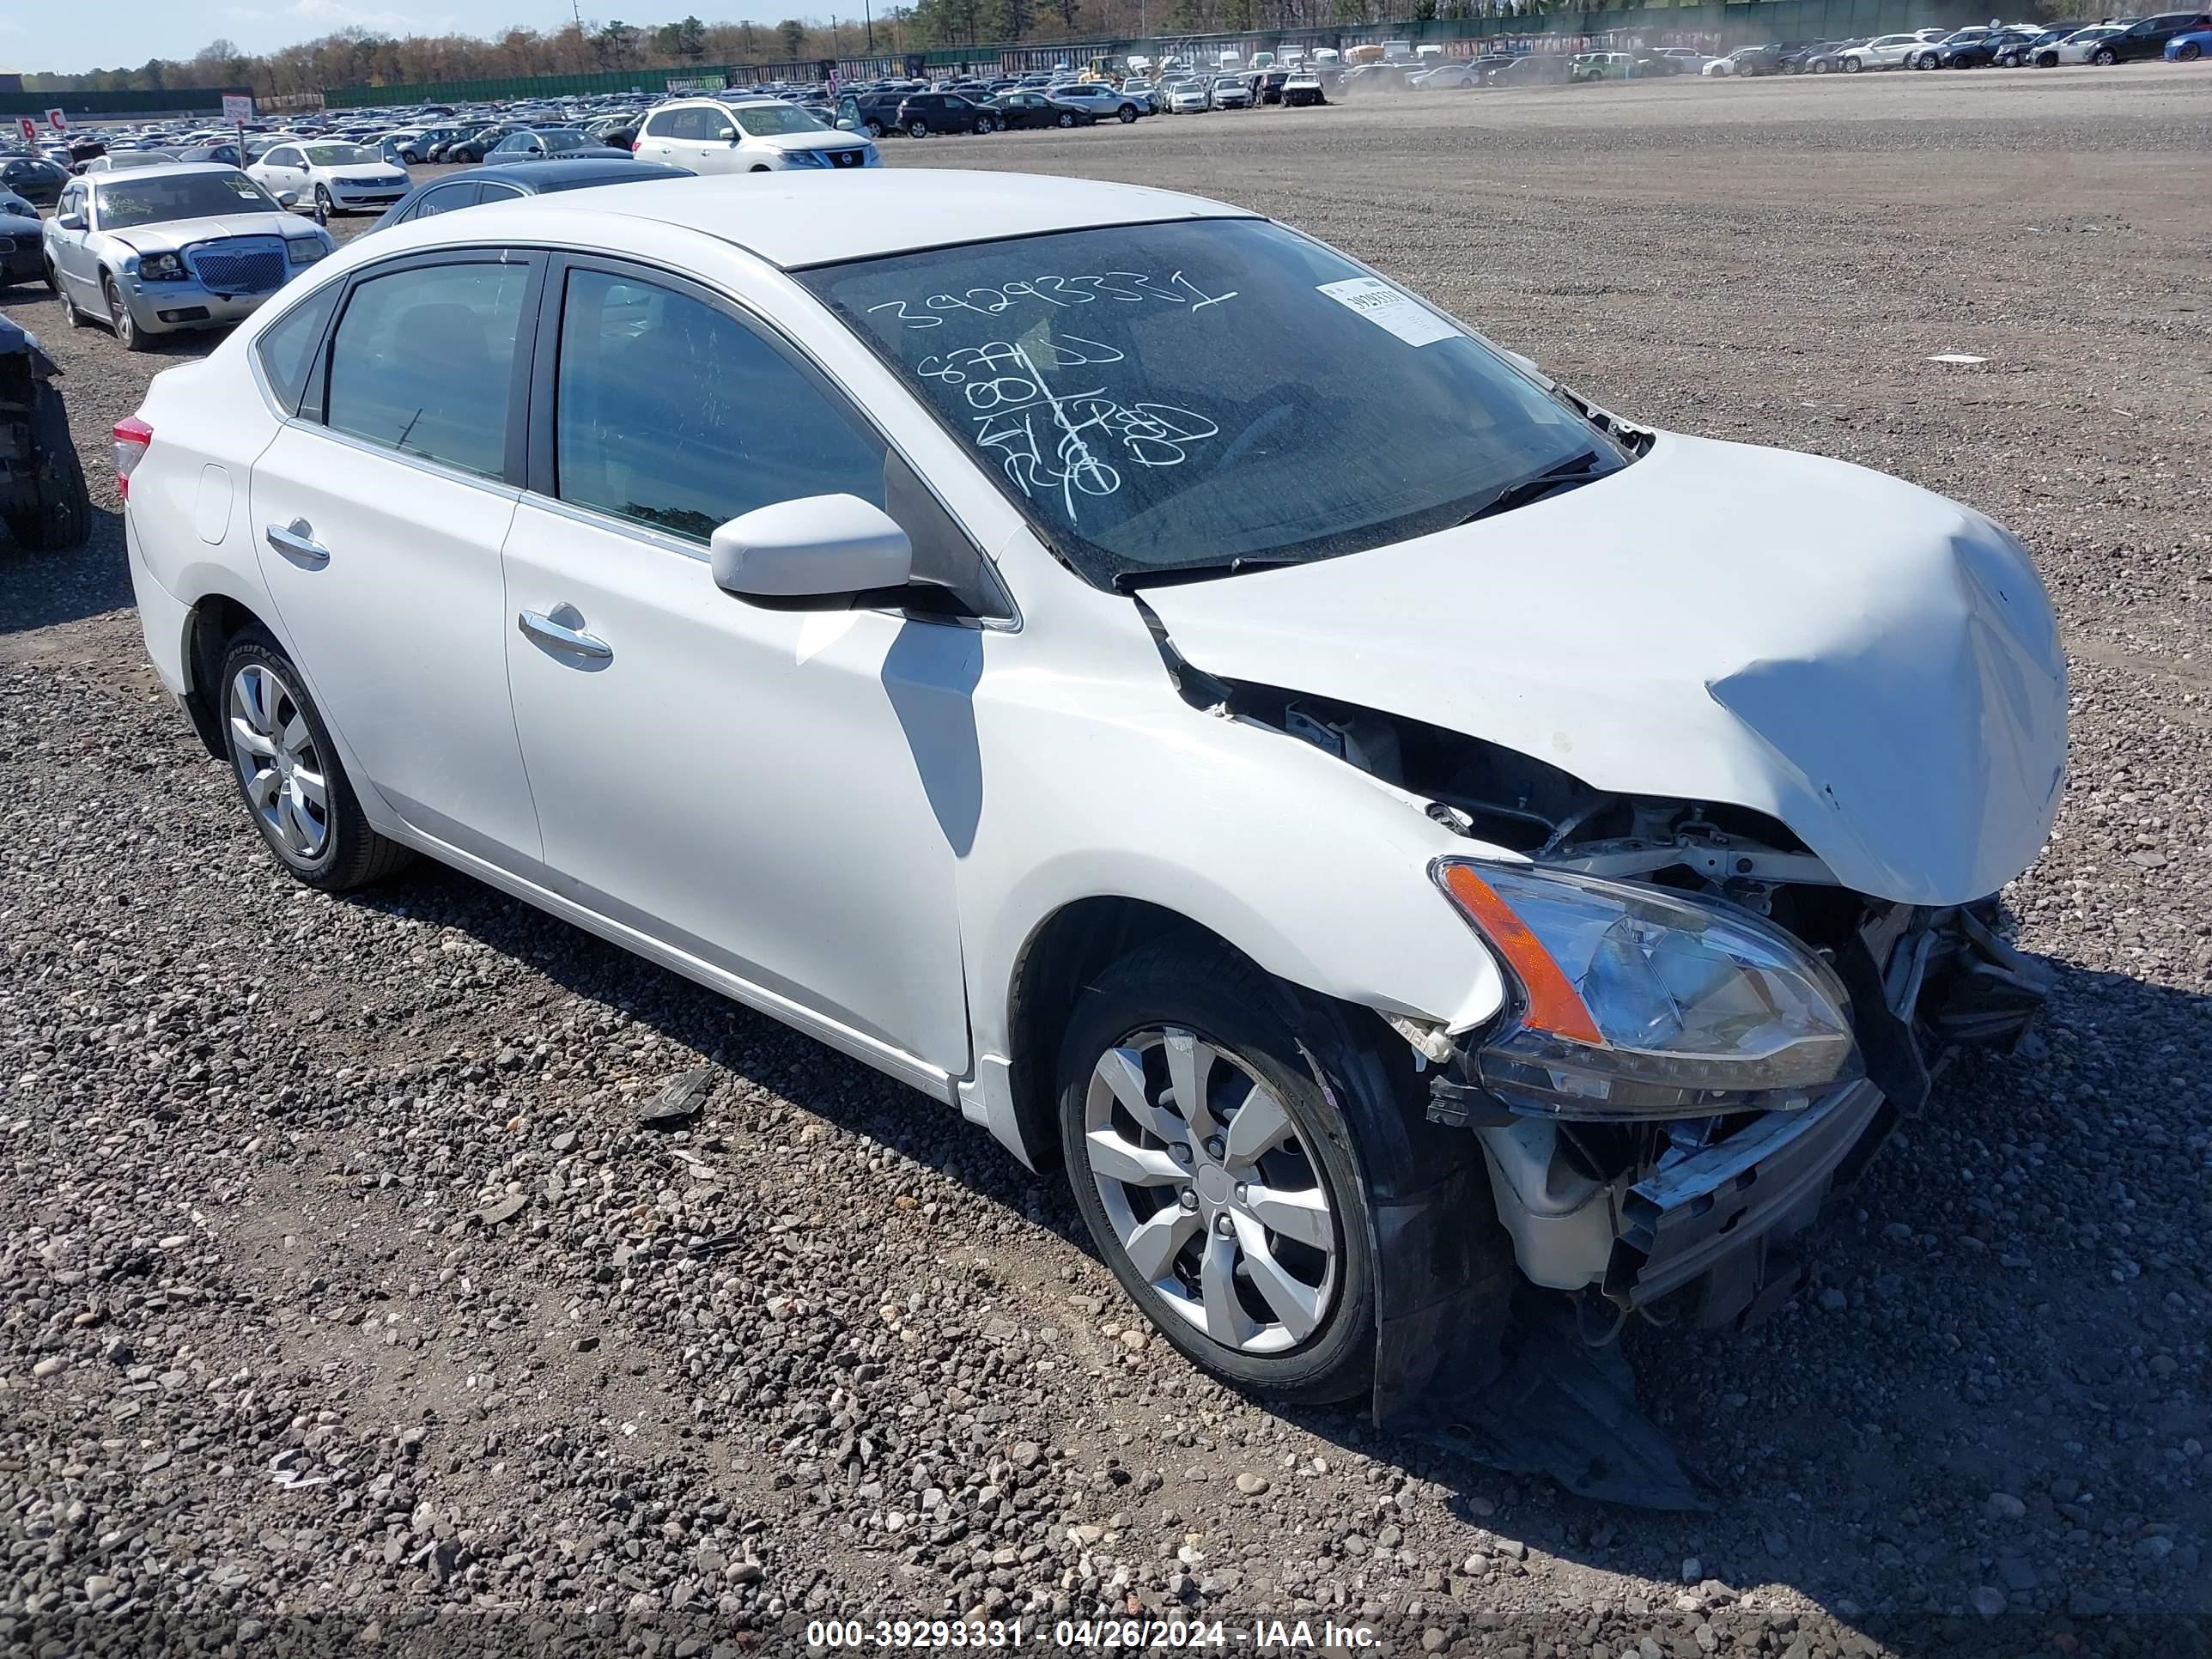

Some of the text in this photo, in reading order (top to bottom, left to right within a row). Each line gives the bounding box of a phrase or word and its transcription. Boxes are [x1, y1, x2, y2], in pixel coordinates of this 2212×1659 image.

[226, 100, 248, 108] DROP
[227, 109, 249, 118] ZONE
[21, 119, 35, 138] B
[51, 111, 65, 130] C
[867, 270, 1238, 329] 39293331
[1346, 290, 1406, 310] 39293331
